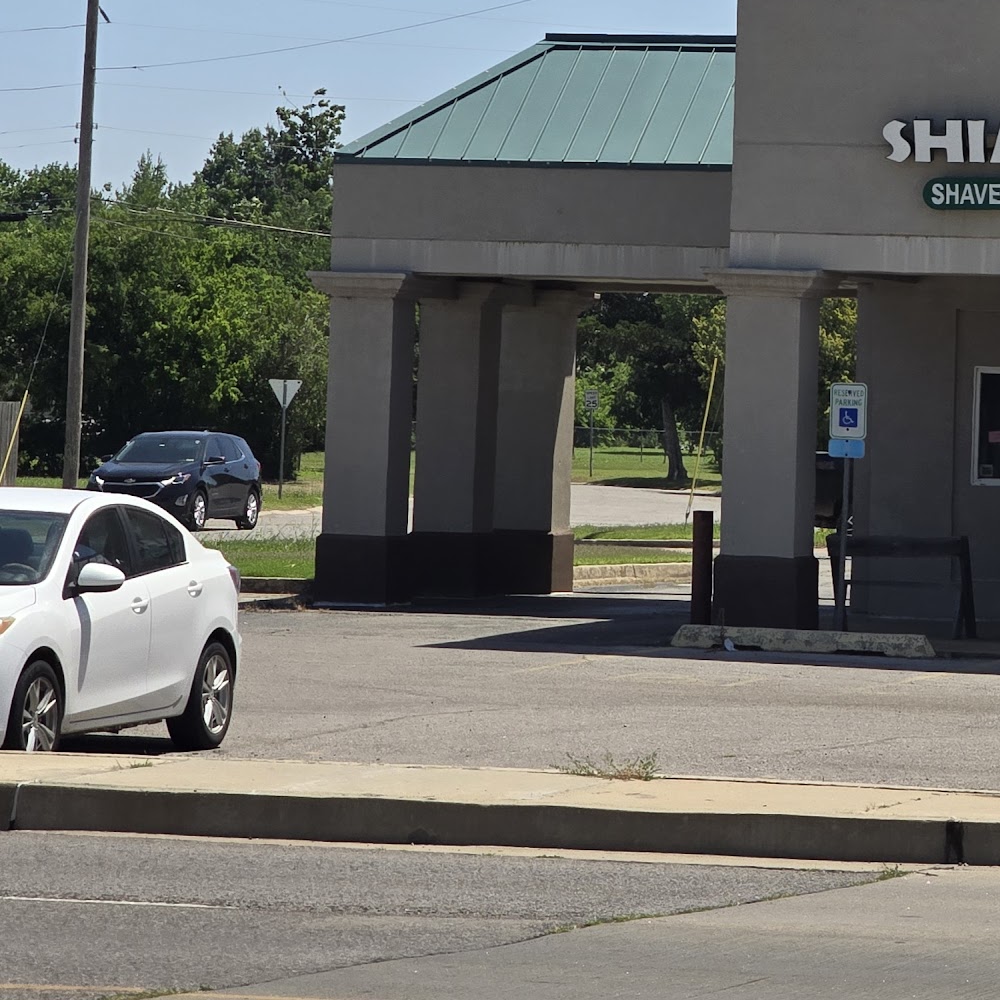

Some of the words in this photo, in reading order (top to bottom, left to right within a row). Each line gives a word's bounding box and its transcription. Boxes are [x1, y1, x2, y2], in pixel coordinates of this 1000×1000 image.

[833, 389, 865, 397] RESERVED
[586, 400, 598, 408] 25
[835, 398, 863, 406] PARKING
